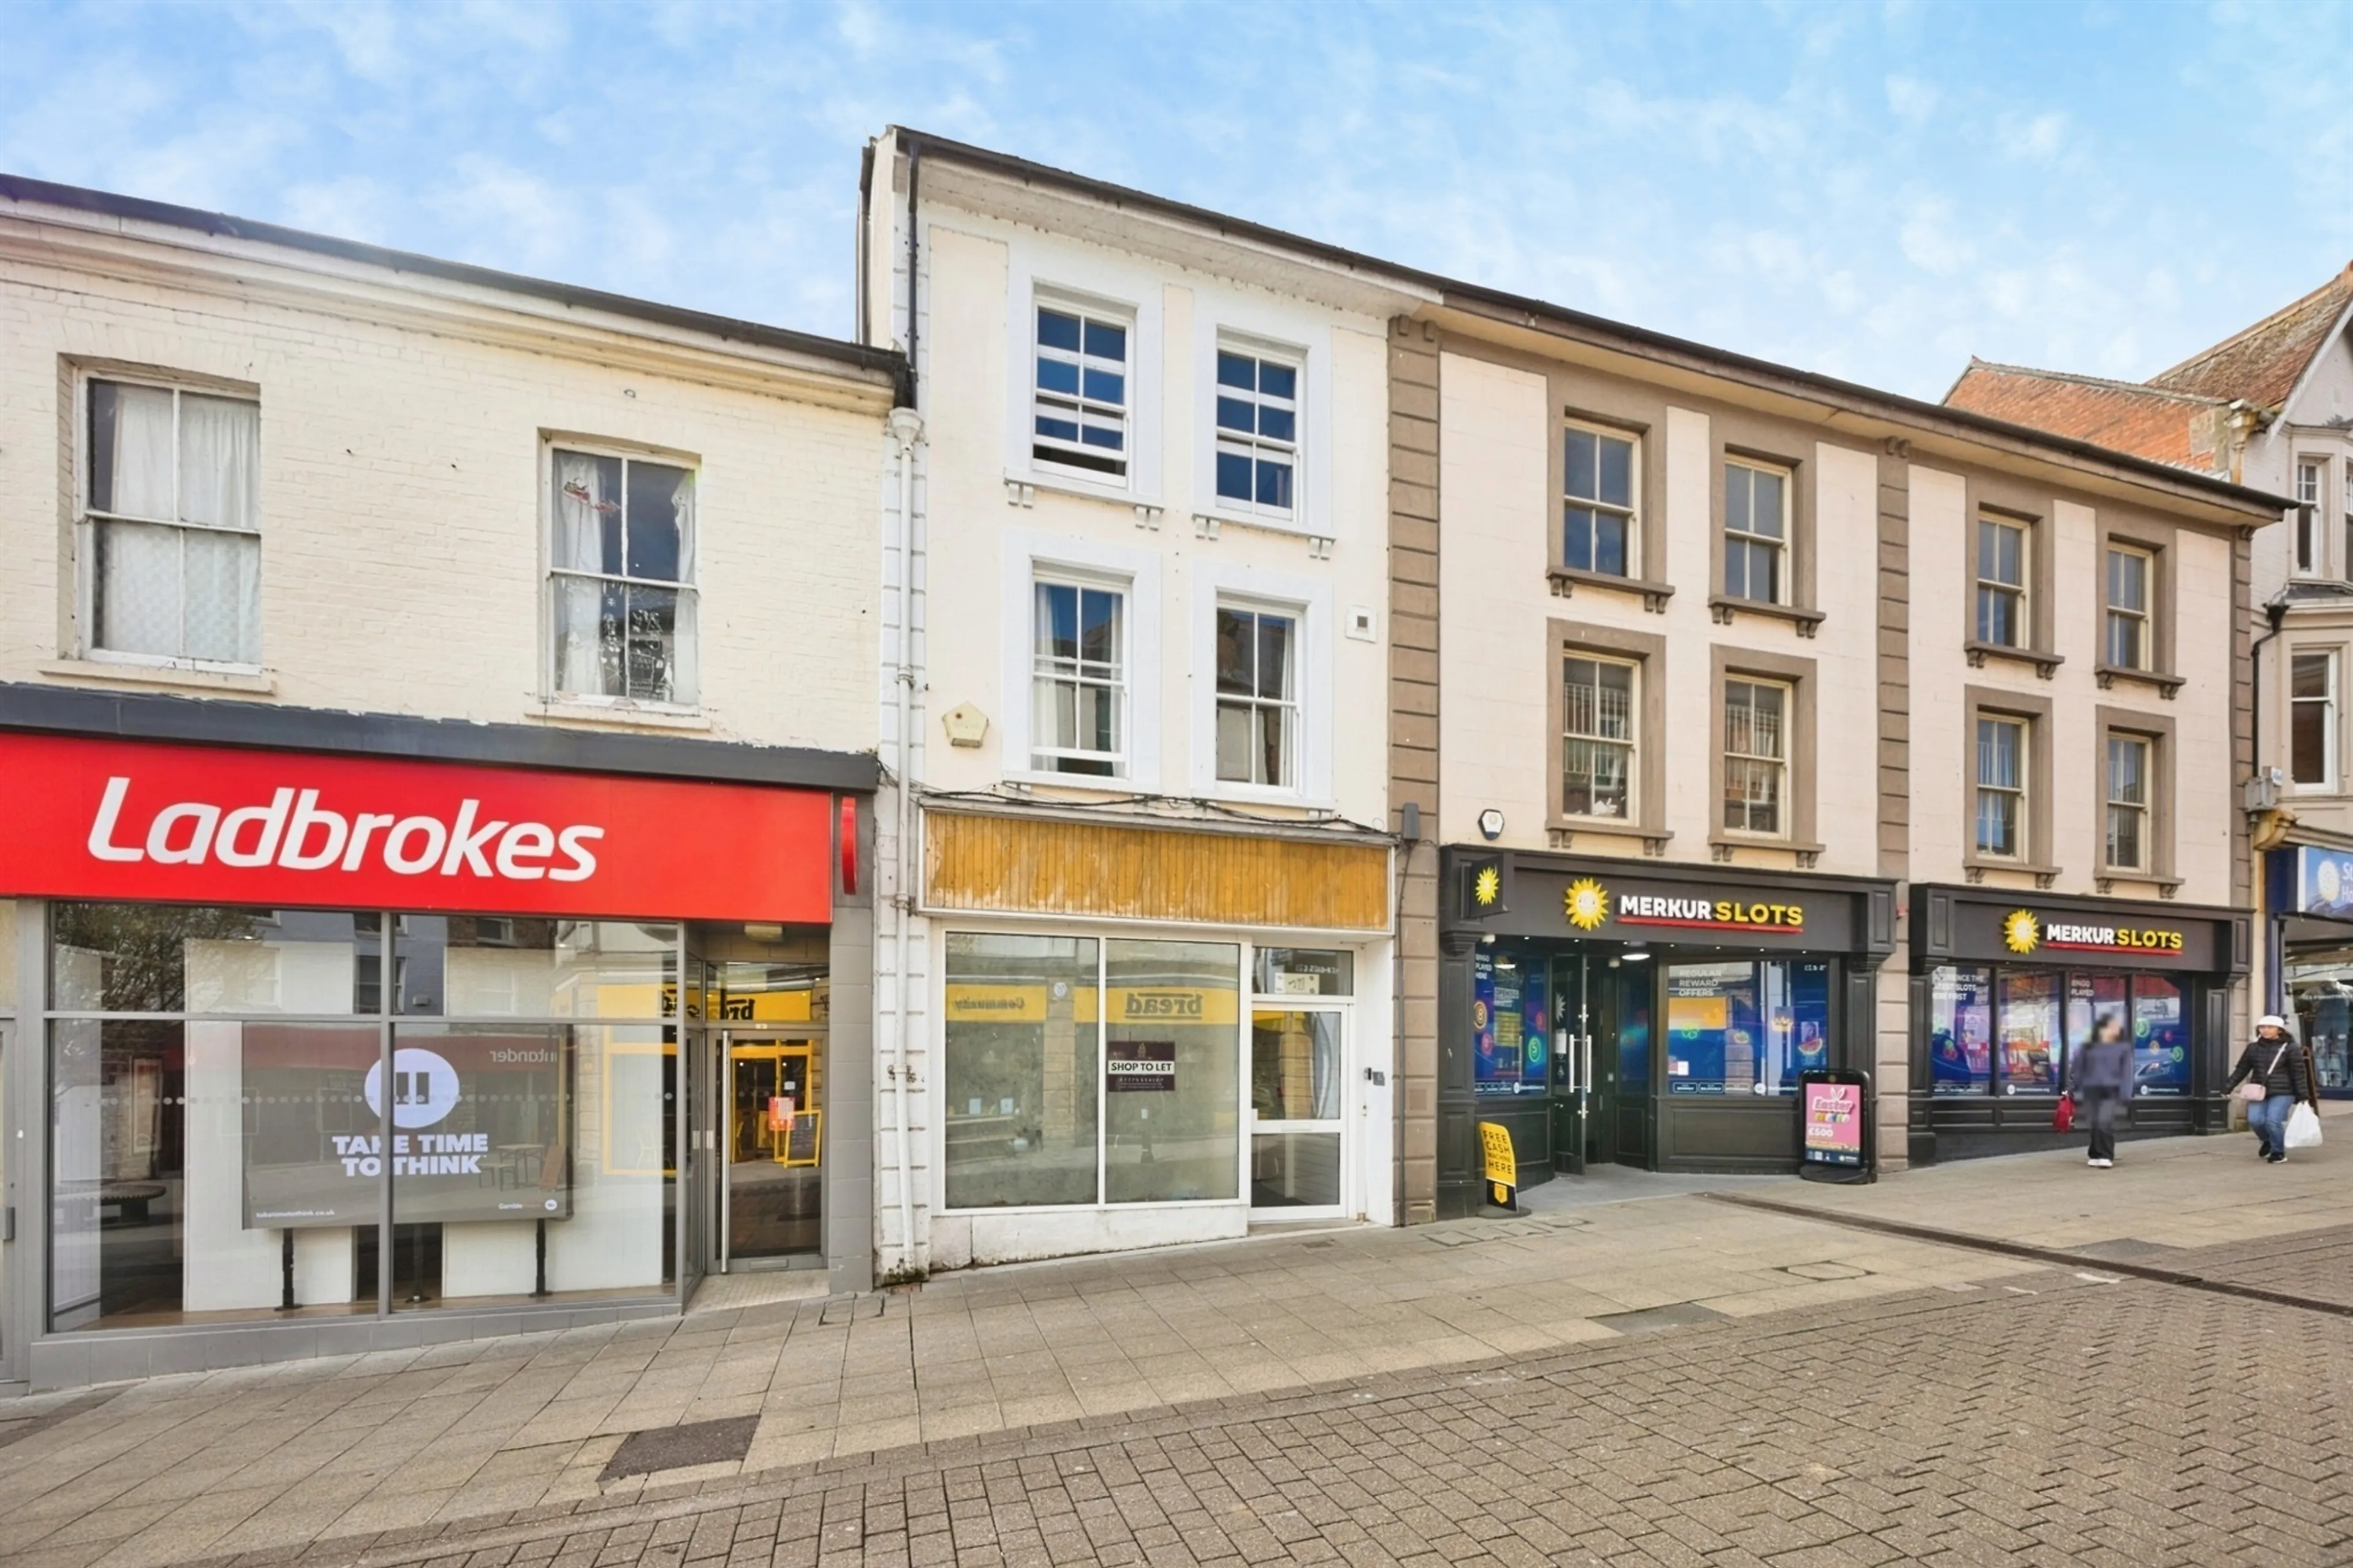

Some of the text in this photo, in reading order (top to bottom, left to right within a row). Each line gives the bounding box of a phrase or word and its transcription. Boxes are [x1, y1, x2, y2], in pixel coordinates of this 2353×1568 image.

[88, 776, 604, 882] Ladbrokes
[1620, 895, 1803, 926] MERKUR SLOTS
[2047, 924, 2183, 949] MERKUR SLOTS
[1679, 988, 1715, 996] OFFERS
[1111, 1062, 1172, 1071] SHOP TO LET
[418, 1134, 488, 1153] TIME
[1483, 1130, 1507, 1144] FREE
[1486, 1141, 1509, 1153] CASH
[341, 1154, 482, 1176] TO THINK
[1488, 1159, 1512, 1175] HERE
